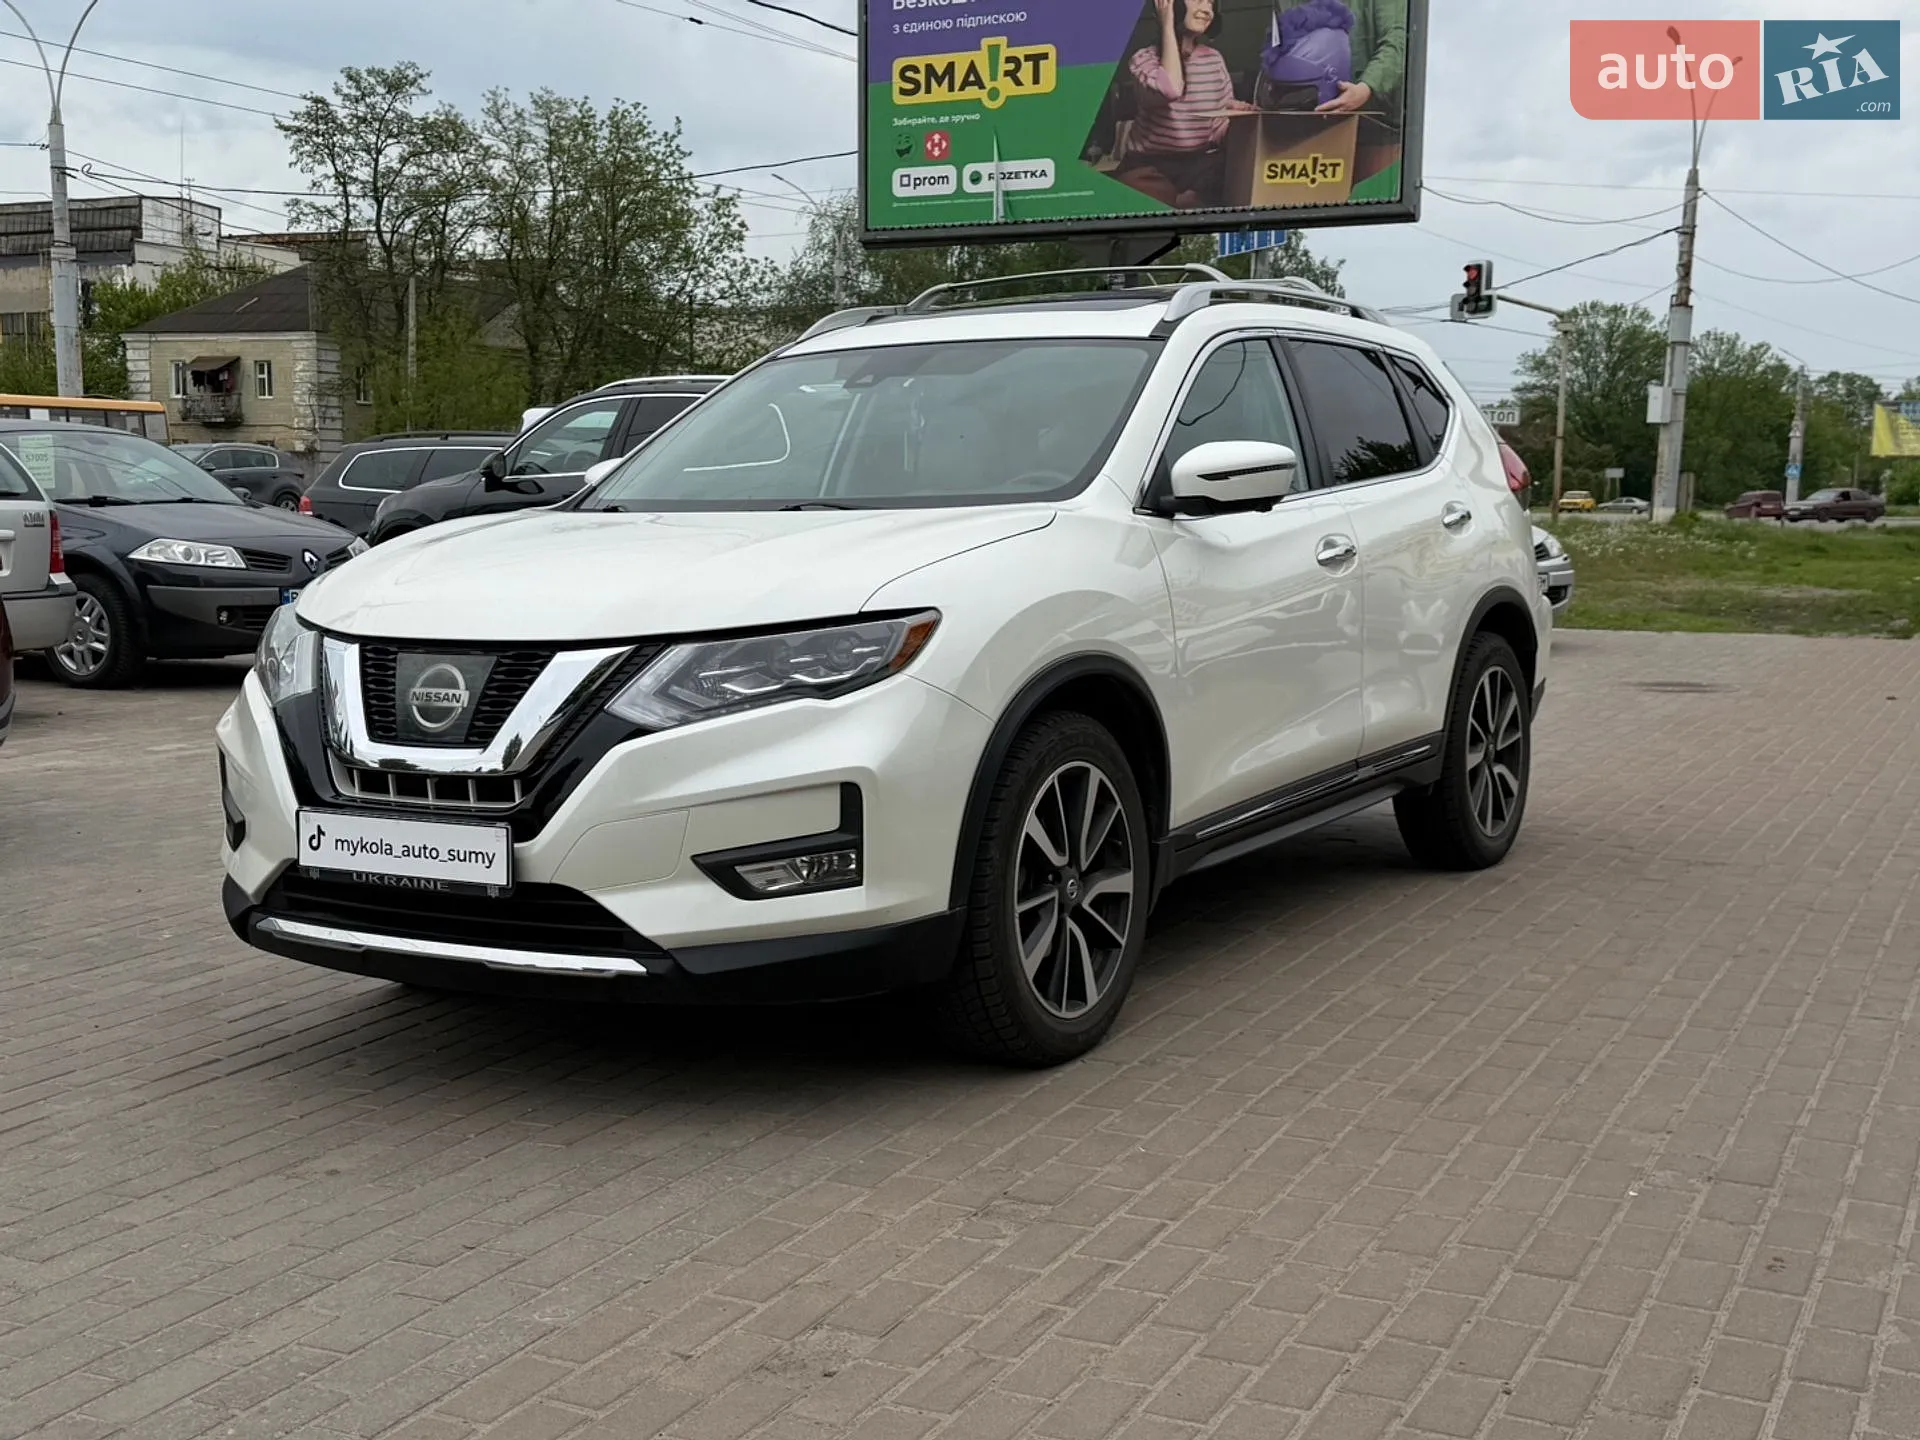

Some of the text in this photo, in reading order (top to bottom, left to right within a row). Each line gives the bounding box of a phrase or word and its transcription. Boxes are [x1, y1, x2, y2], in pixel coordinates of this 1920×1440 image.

[892, 11, 1027, 34] з єдиною підпискою
[951, 113, 981, 124] зручно
[913, 174, 949, 190] prom
[411, 691, 461, 703] NISSAN
[334, 836, 496, 869] mykola_auto_sumy
[353, 872, 449, 891] UKRAINE
